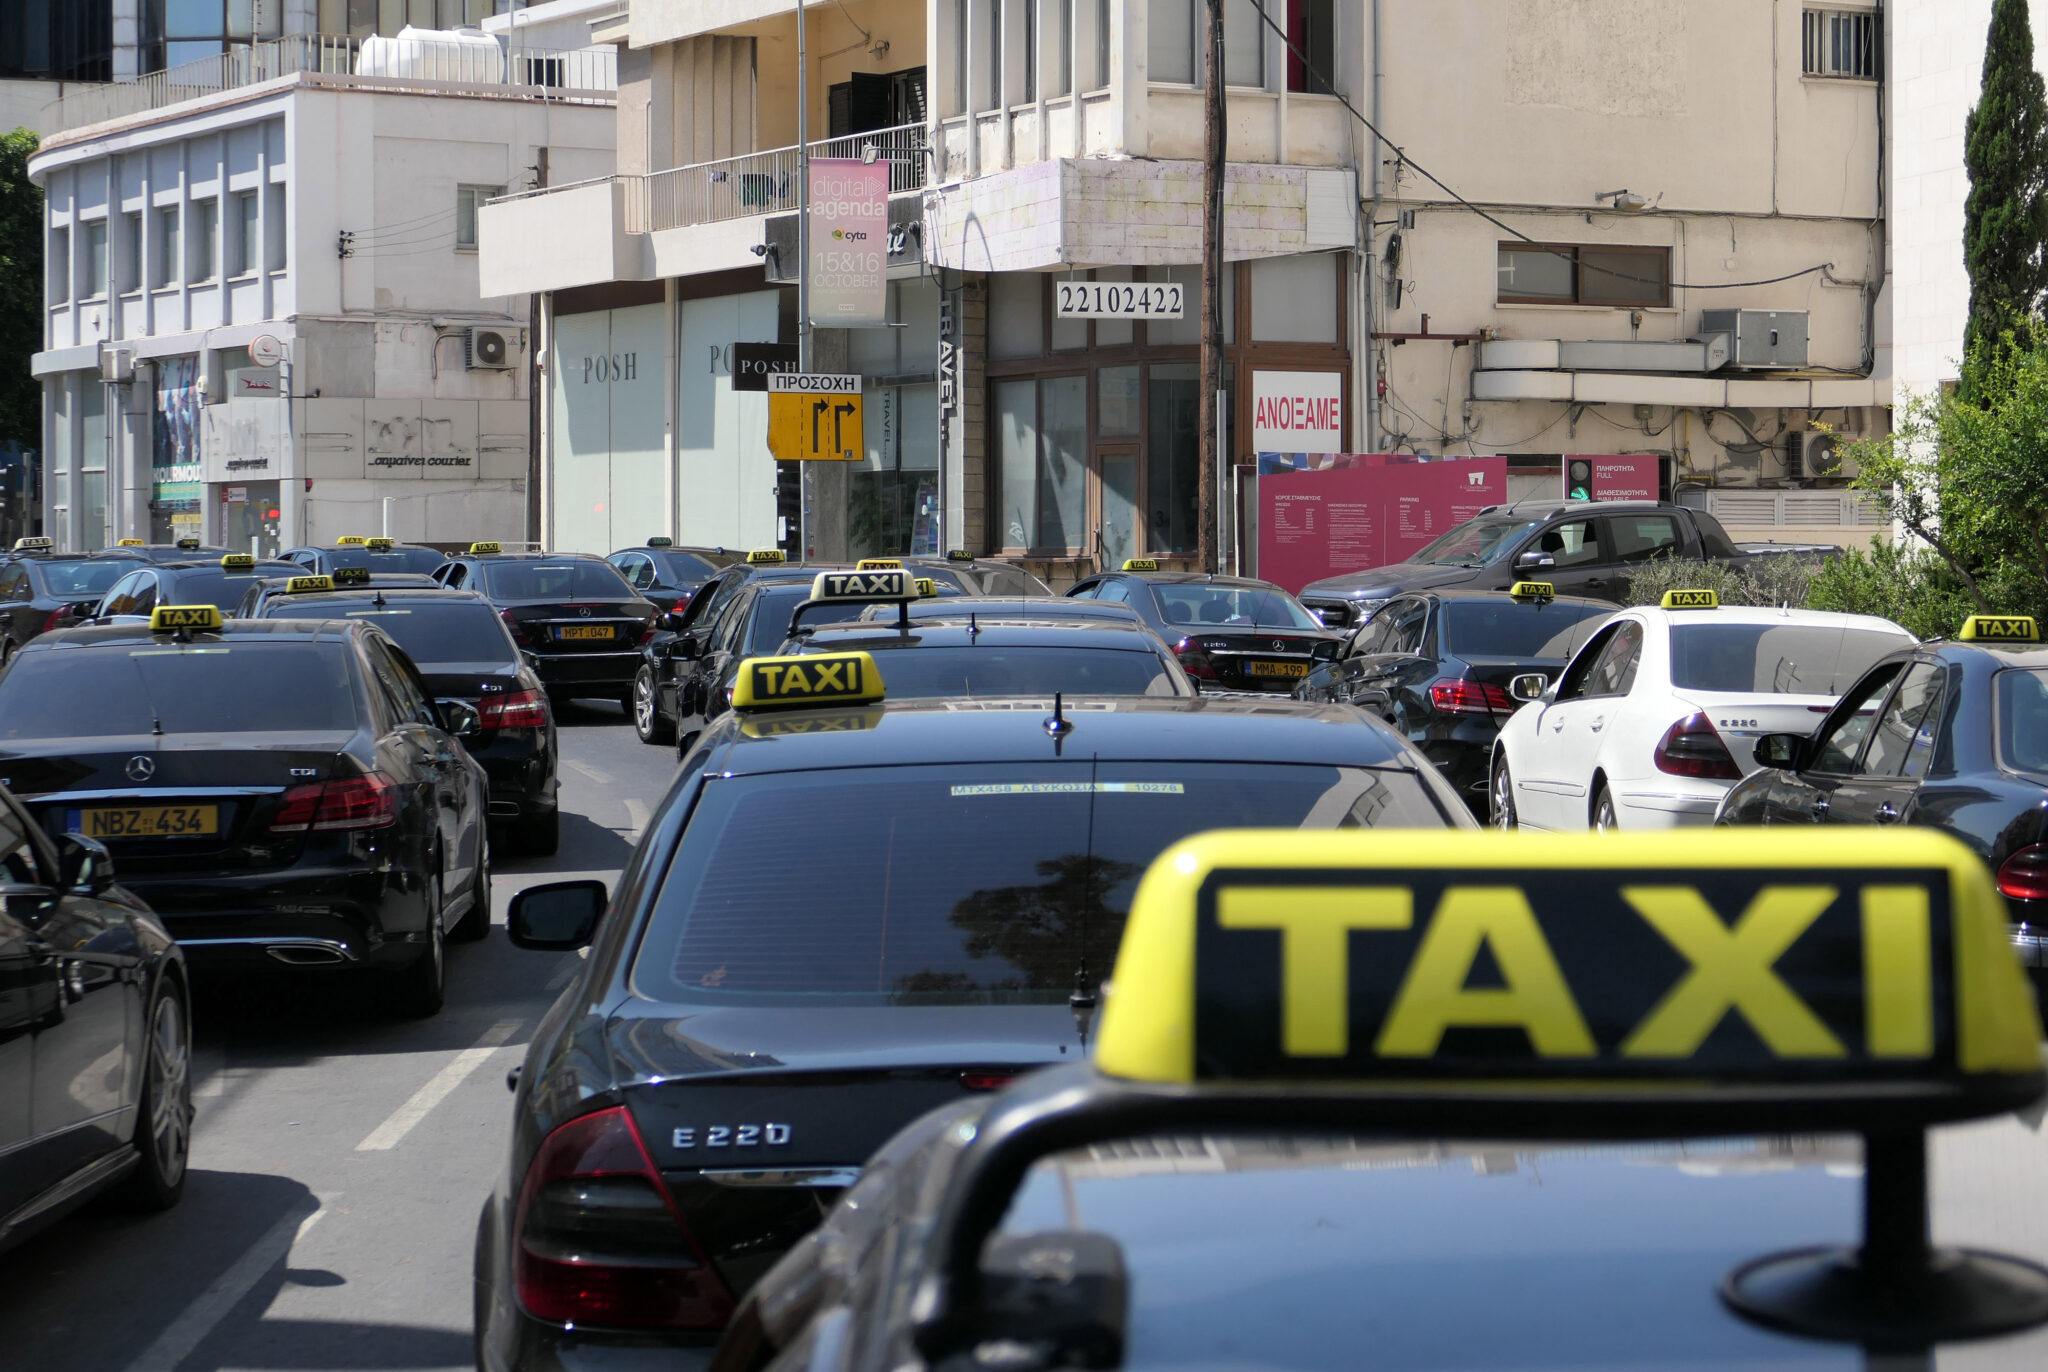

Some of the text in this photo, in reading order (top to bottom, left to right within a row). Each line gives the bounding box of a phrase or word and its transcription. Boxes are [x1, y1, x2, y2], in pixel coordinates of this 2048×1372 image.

[814, 176, 868, 200] digital
[814, 198, 885, 220] agenda
[845, 231, 867, 243] cyta
[816, 252, 879, 273] 15&16
[815, 274, 879, 288] OCTOBER
[1060, 286, 1182, 314] 22102422
[584, 353, 637, 384] POSH
[741, 360, 796, 374] POSH
[776, 375, 855, 391] ΠΡΟΣΟΧΗ
[1255, 396, 1339, 430] ΑΝΟΙΞΑΜΕ
[428, 456, 471, 466] courier
[25, 538, 50, 546] TAXI
[477, 543, 498, 551] TAXI
[755, 551, 779, 560] TAXI
[954, 551, 972, 559] TAXI
[1132, 561, 1154, 569] TAXI
[338, 569, 366, 577] TAXI
[295, 578, 326, 589] TAXI
[829, 575, 899, 594] TAXI
[1523, 584, 1550, 594] TAXI
[1673, 593, 1710, 605] TAXI
[161, 610, 210, 625] TAXI
[564, 627, 608, 638] MPT 047
[1978, 620, 2028, 636] TAXI
[1255, 663, 1275, 675] MMA
[1284, 664, 1303, 677] 199
[758, 661, 857, 695] TAXI
[290, 767, 317, 776] CDI
[1022, 783, 1097, 792] ΛΕΥΚΩΣΙΑ
[92, 811, 141, 835] NBZ
[156, 809, 202, 833] 434
[1216, 884, 1936, 1059] TAXI
[672, 1122, 792, 1148] E 220
